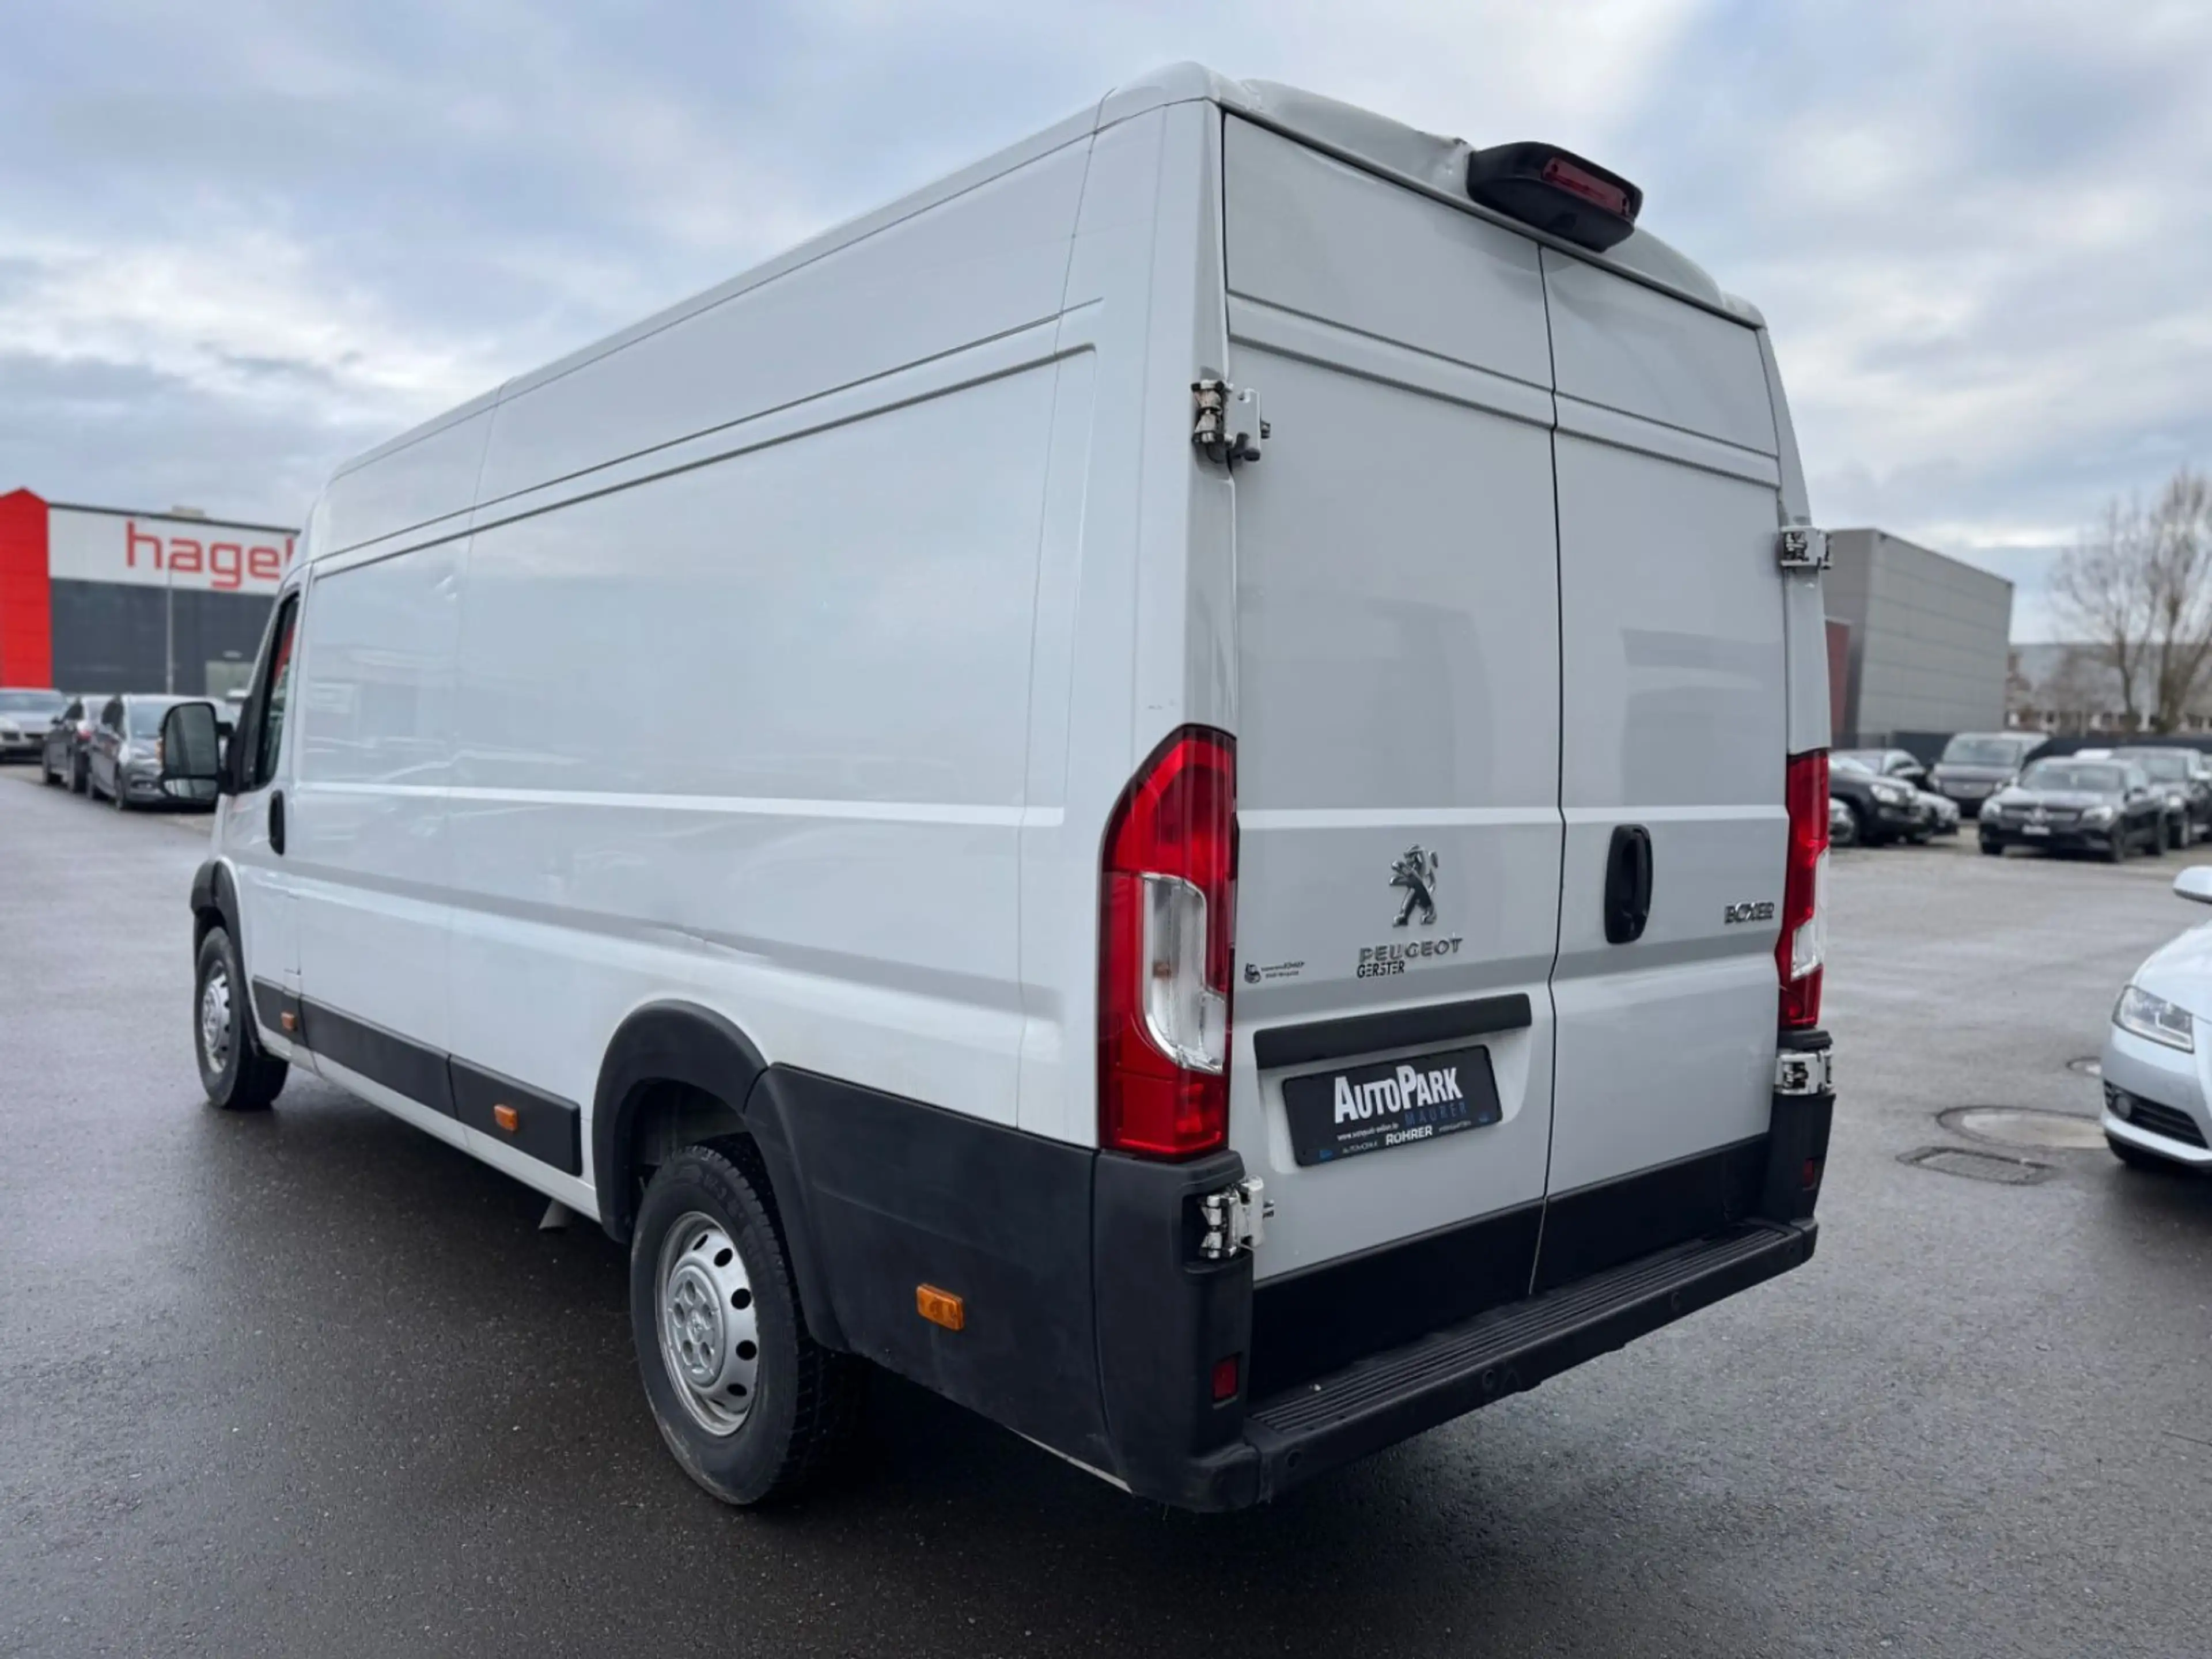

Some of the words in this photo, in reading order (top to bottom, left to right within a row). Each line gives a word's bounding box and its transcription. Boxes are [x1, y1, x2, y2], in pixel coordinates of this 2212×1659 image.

[1359, 937, 1463, 963] PEUGEOT
[1357, 960, 1406, 979] GERSTER
[1385, 1125, 1433, 1146] ROHRER
